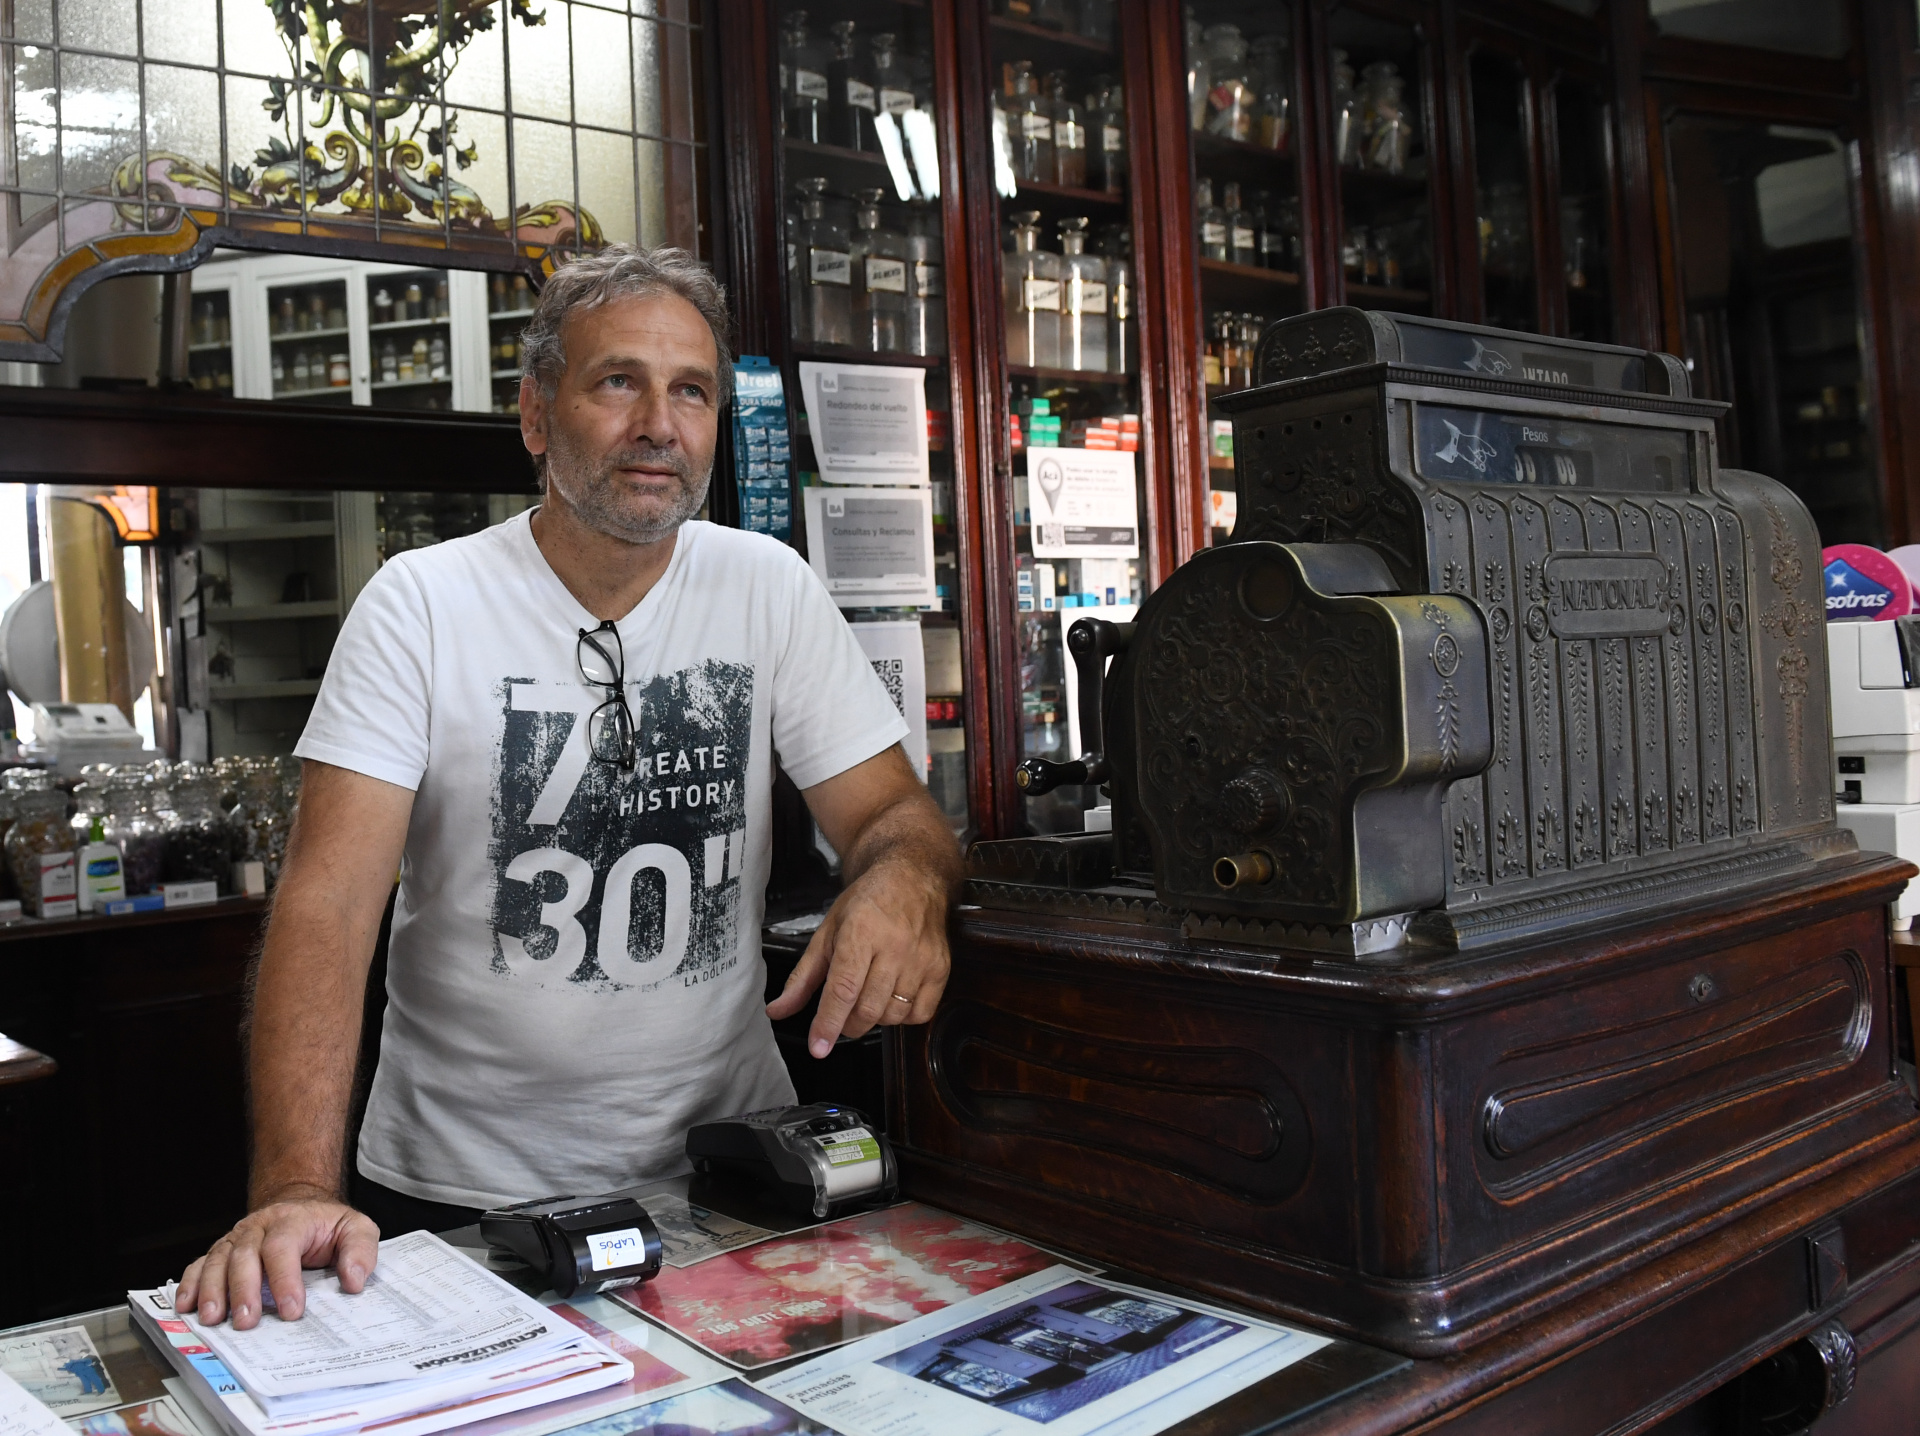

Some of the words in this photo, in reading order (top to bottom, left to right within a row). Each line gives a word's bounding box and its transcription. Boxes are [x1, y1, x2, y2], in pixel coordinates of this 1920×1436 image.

[826, 400, 868, 410] Redondeo
[869, 402, 882, 411] del
[884, 403, 908, 413] vuelto
[1522, 426, 1549, 443] Pesos
[831, 527, 871, 537] Consultas
[879, 527, 915, 537] Reclamos
[1560, 578, 1657, 612] NATIONAL
[1825, 589, 1888, 610] sotras
[639, 745, 727, 780] REATE
[618, 778, 736, 817] HISTORY
[684, 974, 698, 988] LA
[702, 955, 738, 983] DOLFINA
[464, 1316, 525, 1339] Suplemento
[739, 1311, 783, 1327] SIETE
[398, 1344, 437, 1359] Agenda
[413, 1325, 548, 1370] ACTUALIZACIÓN
[786, 1373, 852, 1400] Farmacias
[799, 1380, 857, 1406] Antiguas
